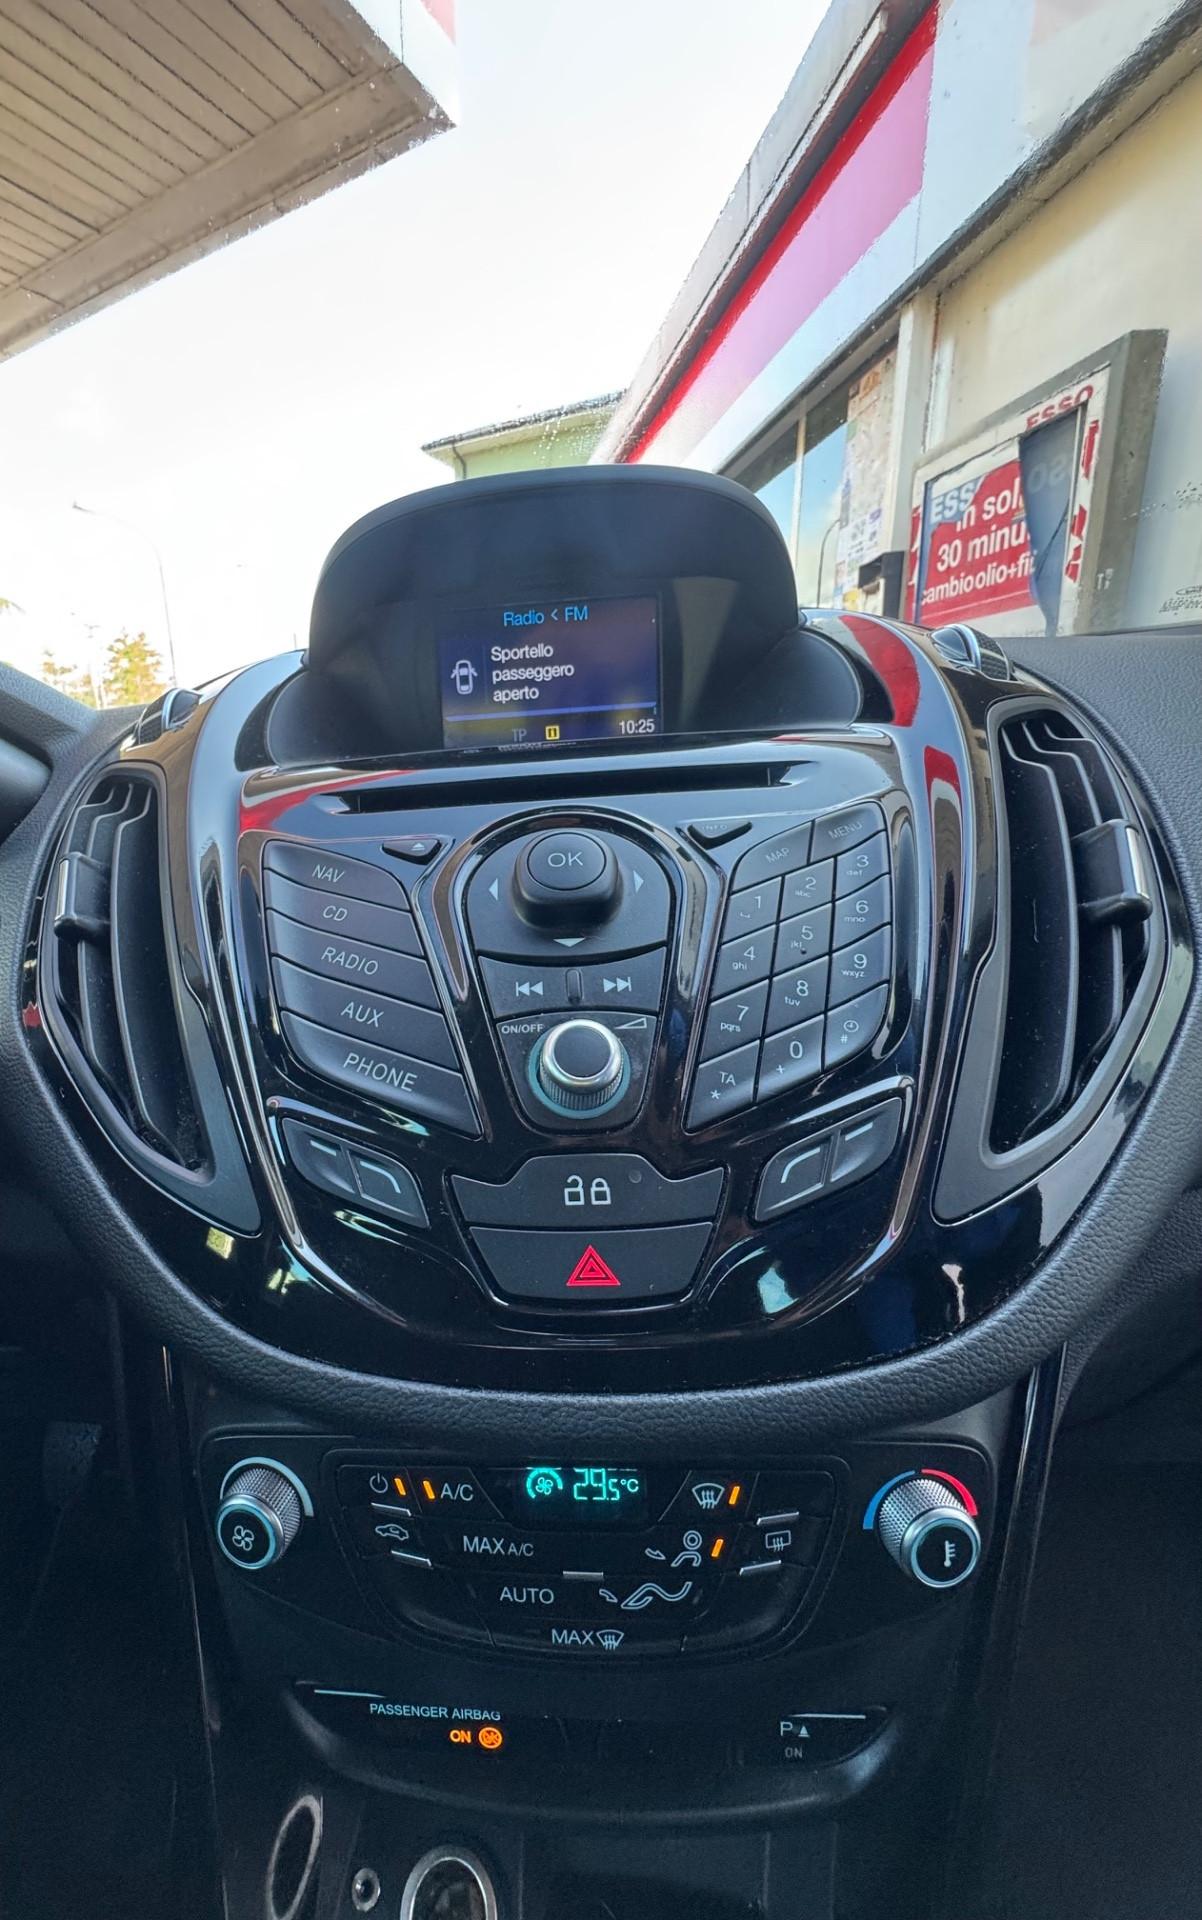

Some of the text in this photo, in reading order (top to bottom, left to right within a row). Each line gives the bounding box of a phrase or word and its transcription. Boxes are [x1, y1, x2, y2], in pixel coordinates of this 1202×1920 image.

[936, 521, 1031, 572] 30 minu
[503, 606, 588, 627] Radio FM
[491, 643, 554, 663] Sportello
[492, 663, 575, 684] passeggero
[493, 686, 539, 704] aperto
[512, 728, 527, 742] TP
[619, 719, 655, 734] 10:25
[828, 822, 863, 839] MENU
[547, 851, 584, 868] OK
[856, 855, 869, 868] 3
[311, 864, 346, 883] NAV
[805, 876, 817, 890] 2
[754, 895, 762, 909] 1
[855, 900, 869, 913] 6
[321, 905, 348, 921] CD
[801, 925, 814, 940] 5
[321, 946, 379, 975] RADIO
[743, 946, 757, 961] 4
[853, 953, 868, 969] 9
[796, 980, 809, 996] 8
[340, 1001, 385, 1028] AUX
[736, 1004, 749, 1021] 7
[501, 1023, 545, 1034] ON/OFF
[789, 1041, 803, 1059] 0
[343, 1052, 418, 1092] PHONE
[719, 1071, 736, 1086] TA
[440, 1484, 474, 1501] A/C
[463, 1535, 534, 1557] MAX A/C
[500, 1586, 554, 1604] AUTO
[551, 1629, 594, 1645] MAX
[369, 1703, 501, 1721] PASSENGER AIRBAG
[450, 1729, 472, 1743] ON
[785, 1747, 803, 1758] ON
